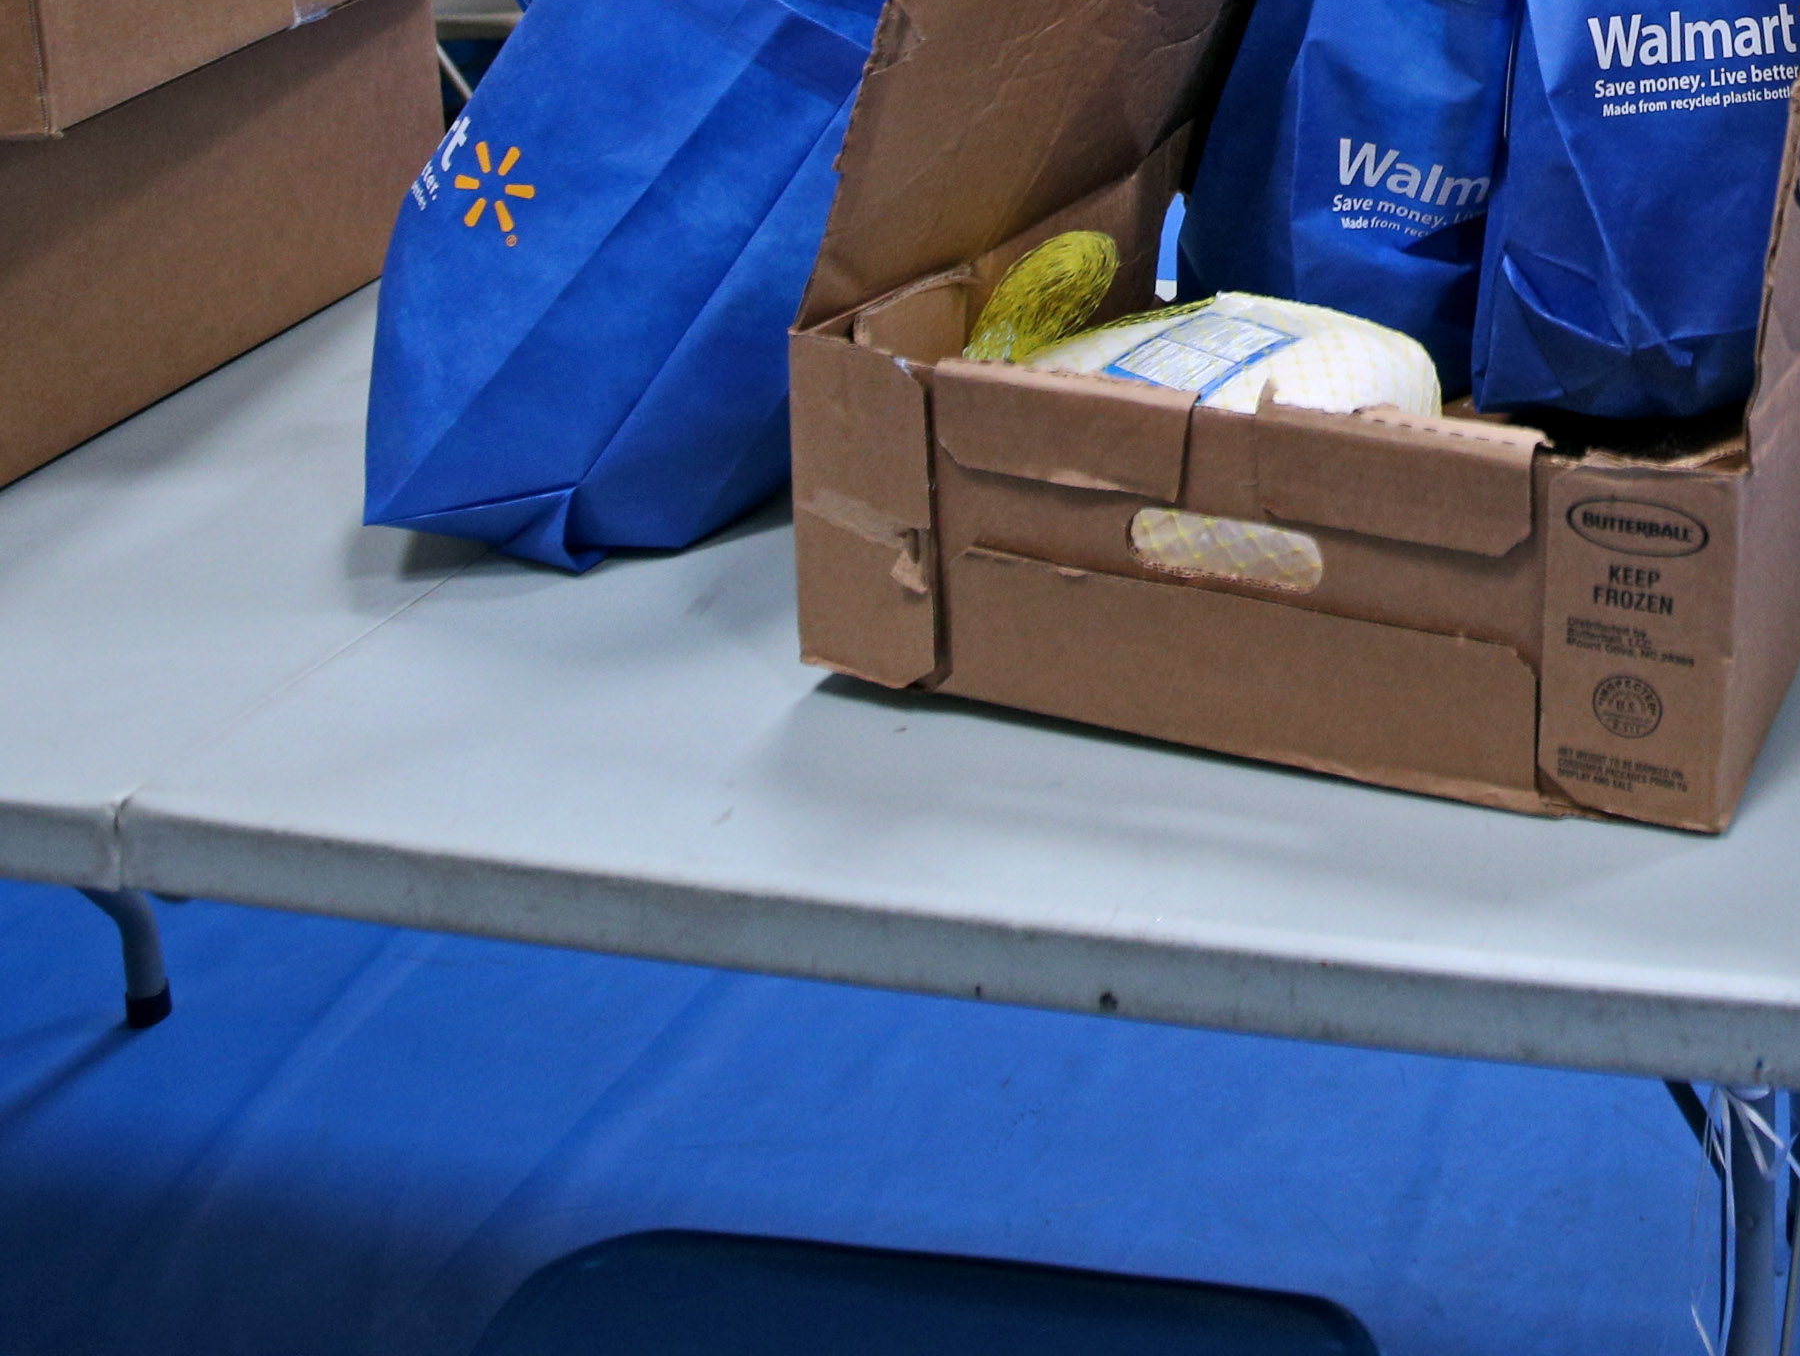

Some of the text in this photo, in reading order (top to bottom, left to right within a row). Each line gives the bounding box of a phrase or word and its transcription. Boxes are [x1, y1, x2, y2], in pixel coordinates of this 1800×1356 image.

[1587, 3, 1797, 70] Walmart
[1595, 79, 1635, 98] Save
[1640, 74, 1705, 94] money.
[1710, 68, 1747, 86] Live
[1603, 86, 1793, 117] Made from recycled plastic bottl
[1339, 138, 1490, 206] Walm
[1332, 194, 1373, 212] Save
[1376, 200, 1447, 228] money.
[1341, 216, 1369, 229] Made
[1371, 216, 1400, 231] from
[1582, 511, 1693, 542] BUTTERBALL
[1609, 564, 1660, 587] KEEP
[1593, 585, 1673, 615] FROZEN
